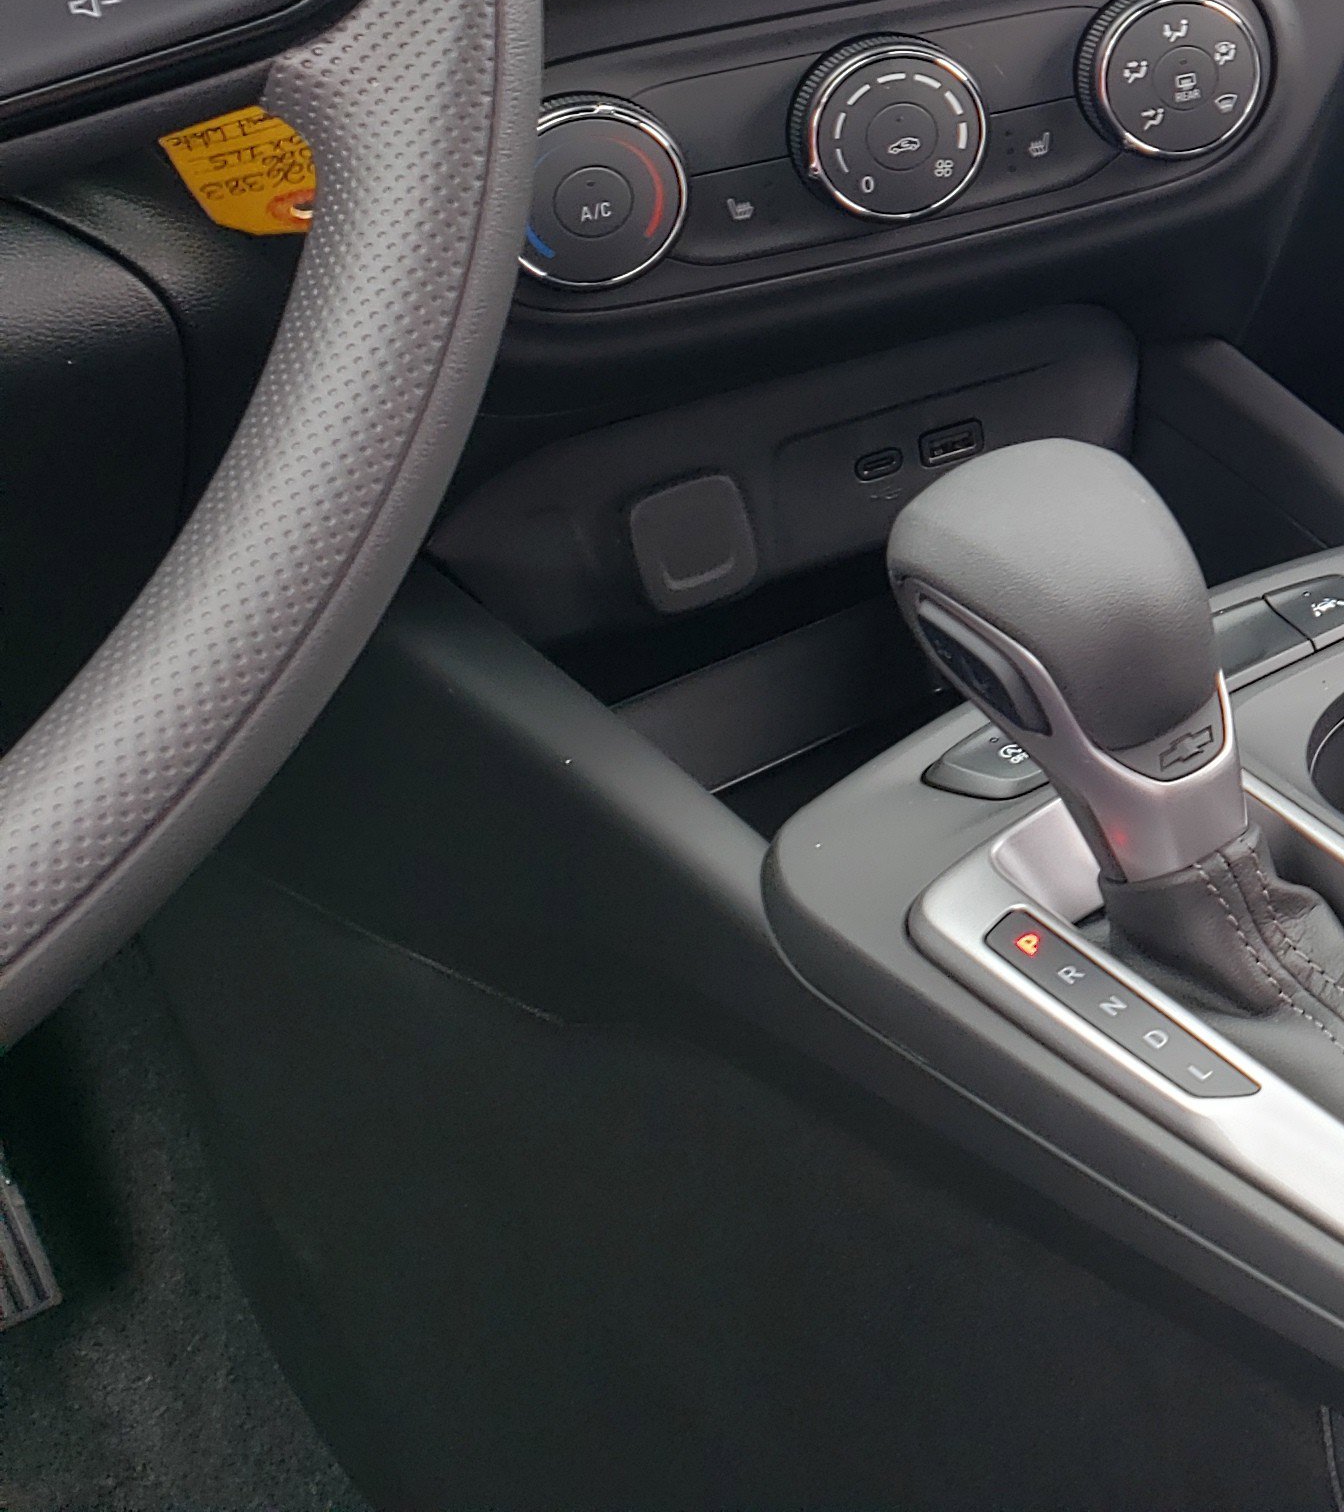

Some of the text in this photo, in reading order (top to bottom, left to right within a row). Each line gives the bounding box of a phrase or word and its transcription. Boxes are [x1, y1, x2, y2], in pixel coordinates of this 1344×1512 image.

[580, 201, 612, 223] A/C
[1058, 965, 1085, 984] R
[1099, 995, 1127, 1016] N
[1143, 1029, 1169, 1049] D
[1187, 1064, 1213, 1080] L
